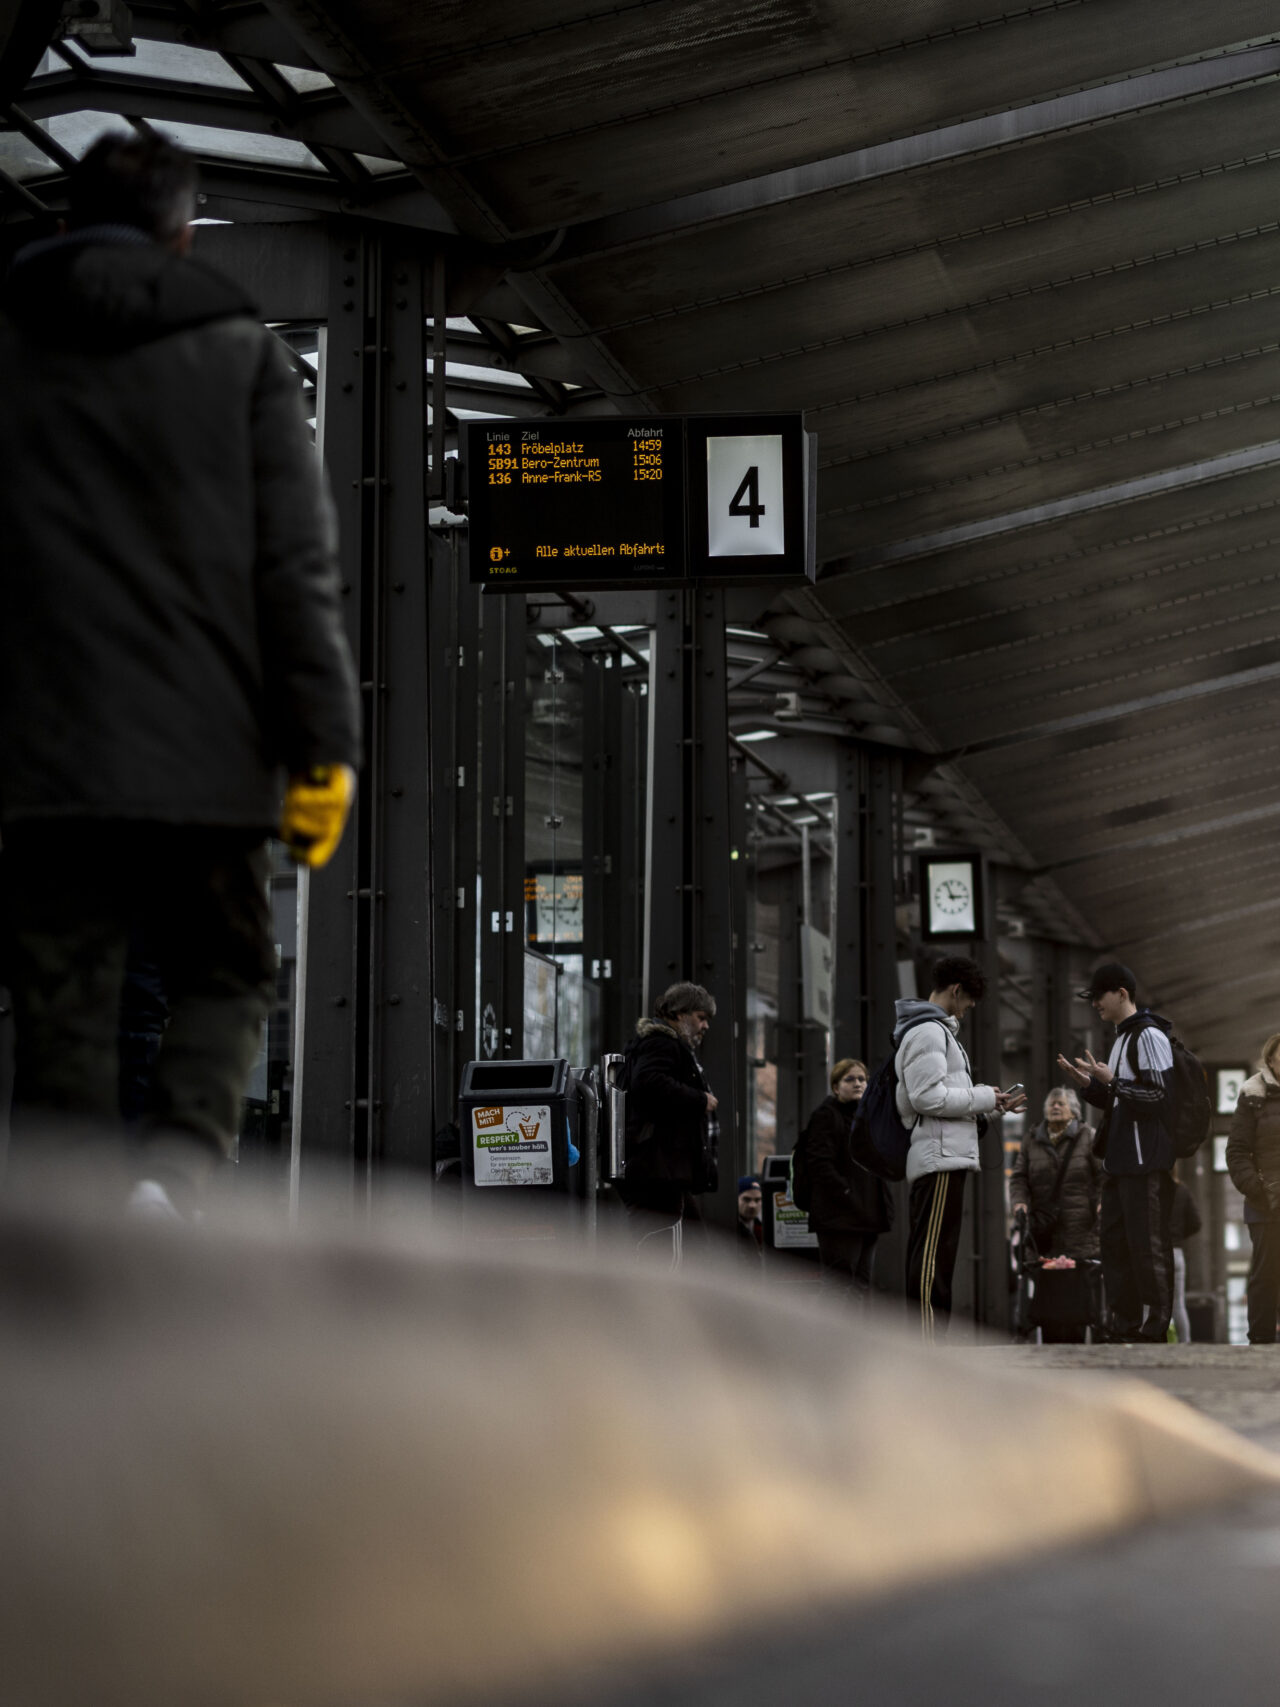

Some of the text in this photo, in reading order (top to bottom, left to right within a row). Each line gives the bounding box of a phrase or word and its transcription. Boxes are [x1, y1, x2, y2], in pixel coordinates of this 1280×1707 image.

[486, 431, 540, 442] Linie Ziel
[627, 428, 664, 438] Abfahrt
[488, 439, 662, 456] 143 Fröbelplatz 14:59
[488, 453, 663, 470] SB91 Bero-Zentrum 15:06
[488, 468, 663, 485] 136 Anne-Frank-RS 15:20
[729, 466, 765, 528] 4
[536, 545, 559, 558] Alle
[564, 544, 615, 557] aktuellen
[489, 566, 518, 575] STOAG
[1227, 1080, 1238, 1101] 3
[477, 1108, 501, 1119] MACH
[480, 1134, 518, 1145] RESPEKT,
